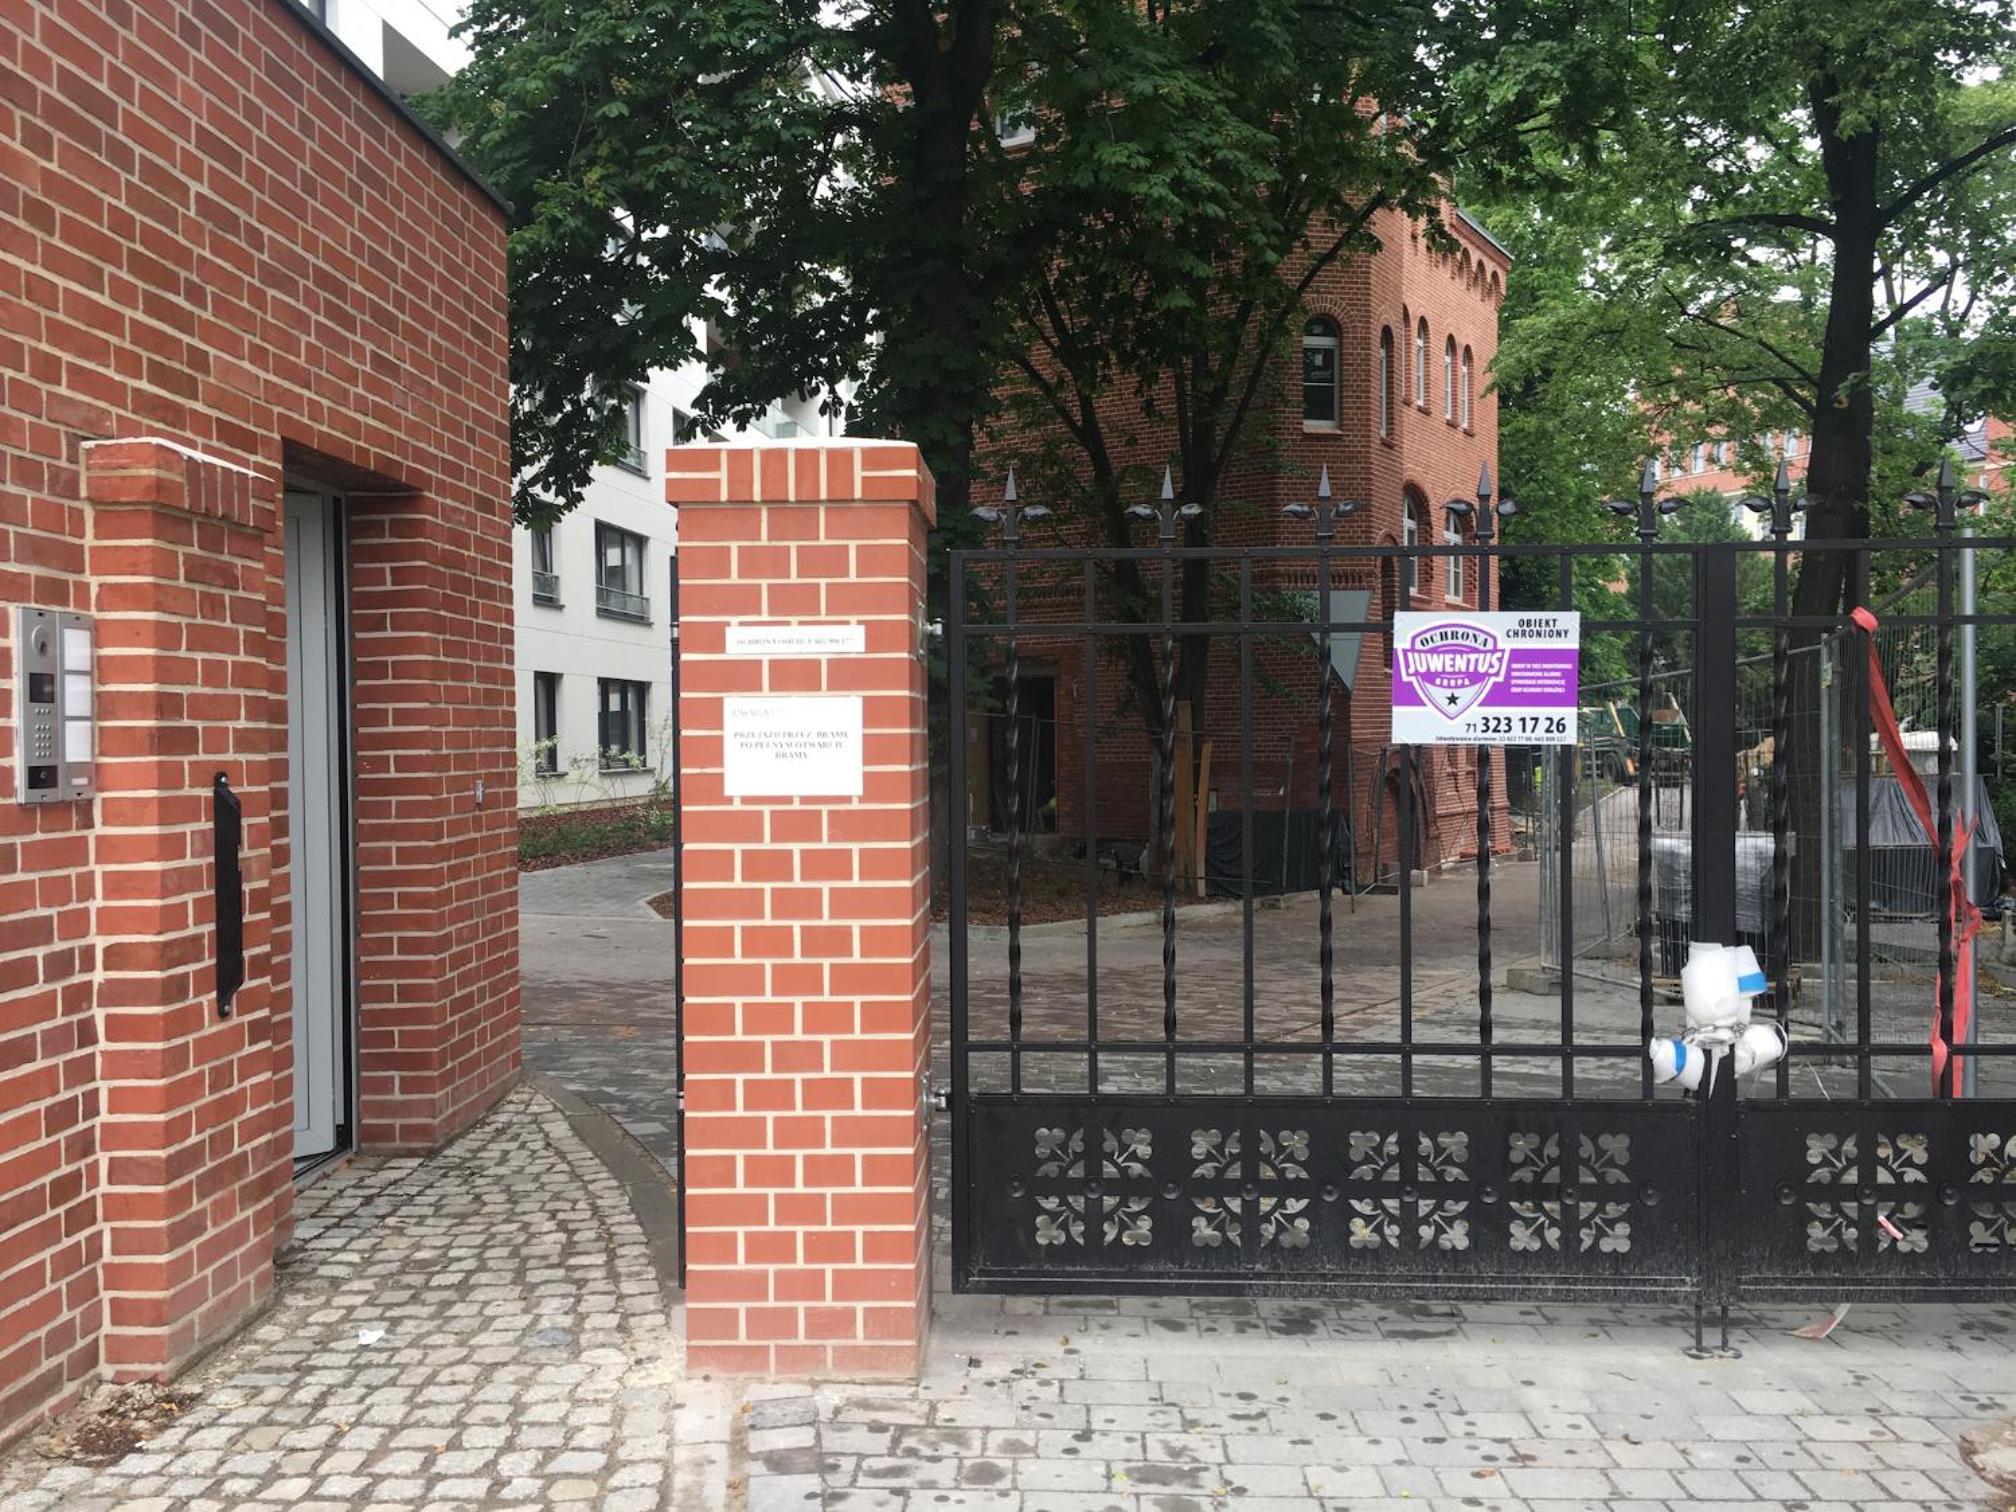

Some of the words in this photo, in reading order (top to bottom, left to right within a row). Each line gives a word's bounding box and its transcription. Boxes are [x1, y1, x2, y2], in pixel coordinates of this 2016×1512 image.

[1518, 618, 1558, 628] OBIEKT
[1419, 629, 1489, 648] OCHRONA
[1506, 629, 1570, 638] CHRONIONY
[1407, 651, 1503, 675] JUWENTUS
[1435, 677, 1470, 687] GRUPA
[1465, 723, 1477, 733] 71
[1480, 716, 1513, 734] 323
[1519, 716, 1540, 733] 17
[1544, 716, 1567, 733] 26
